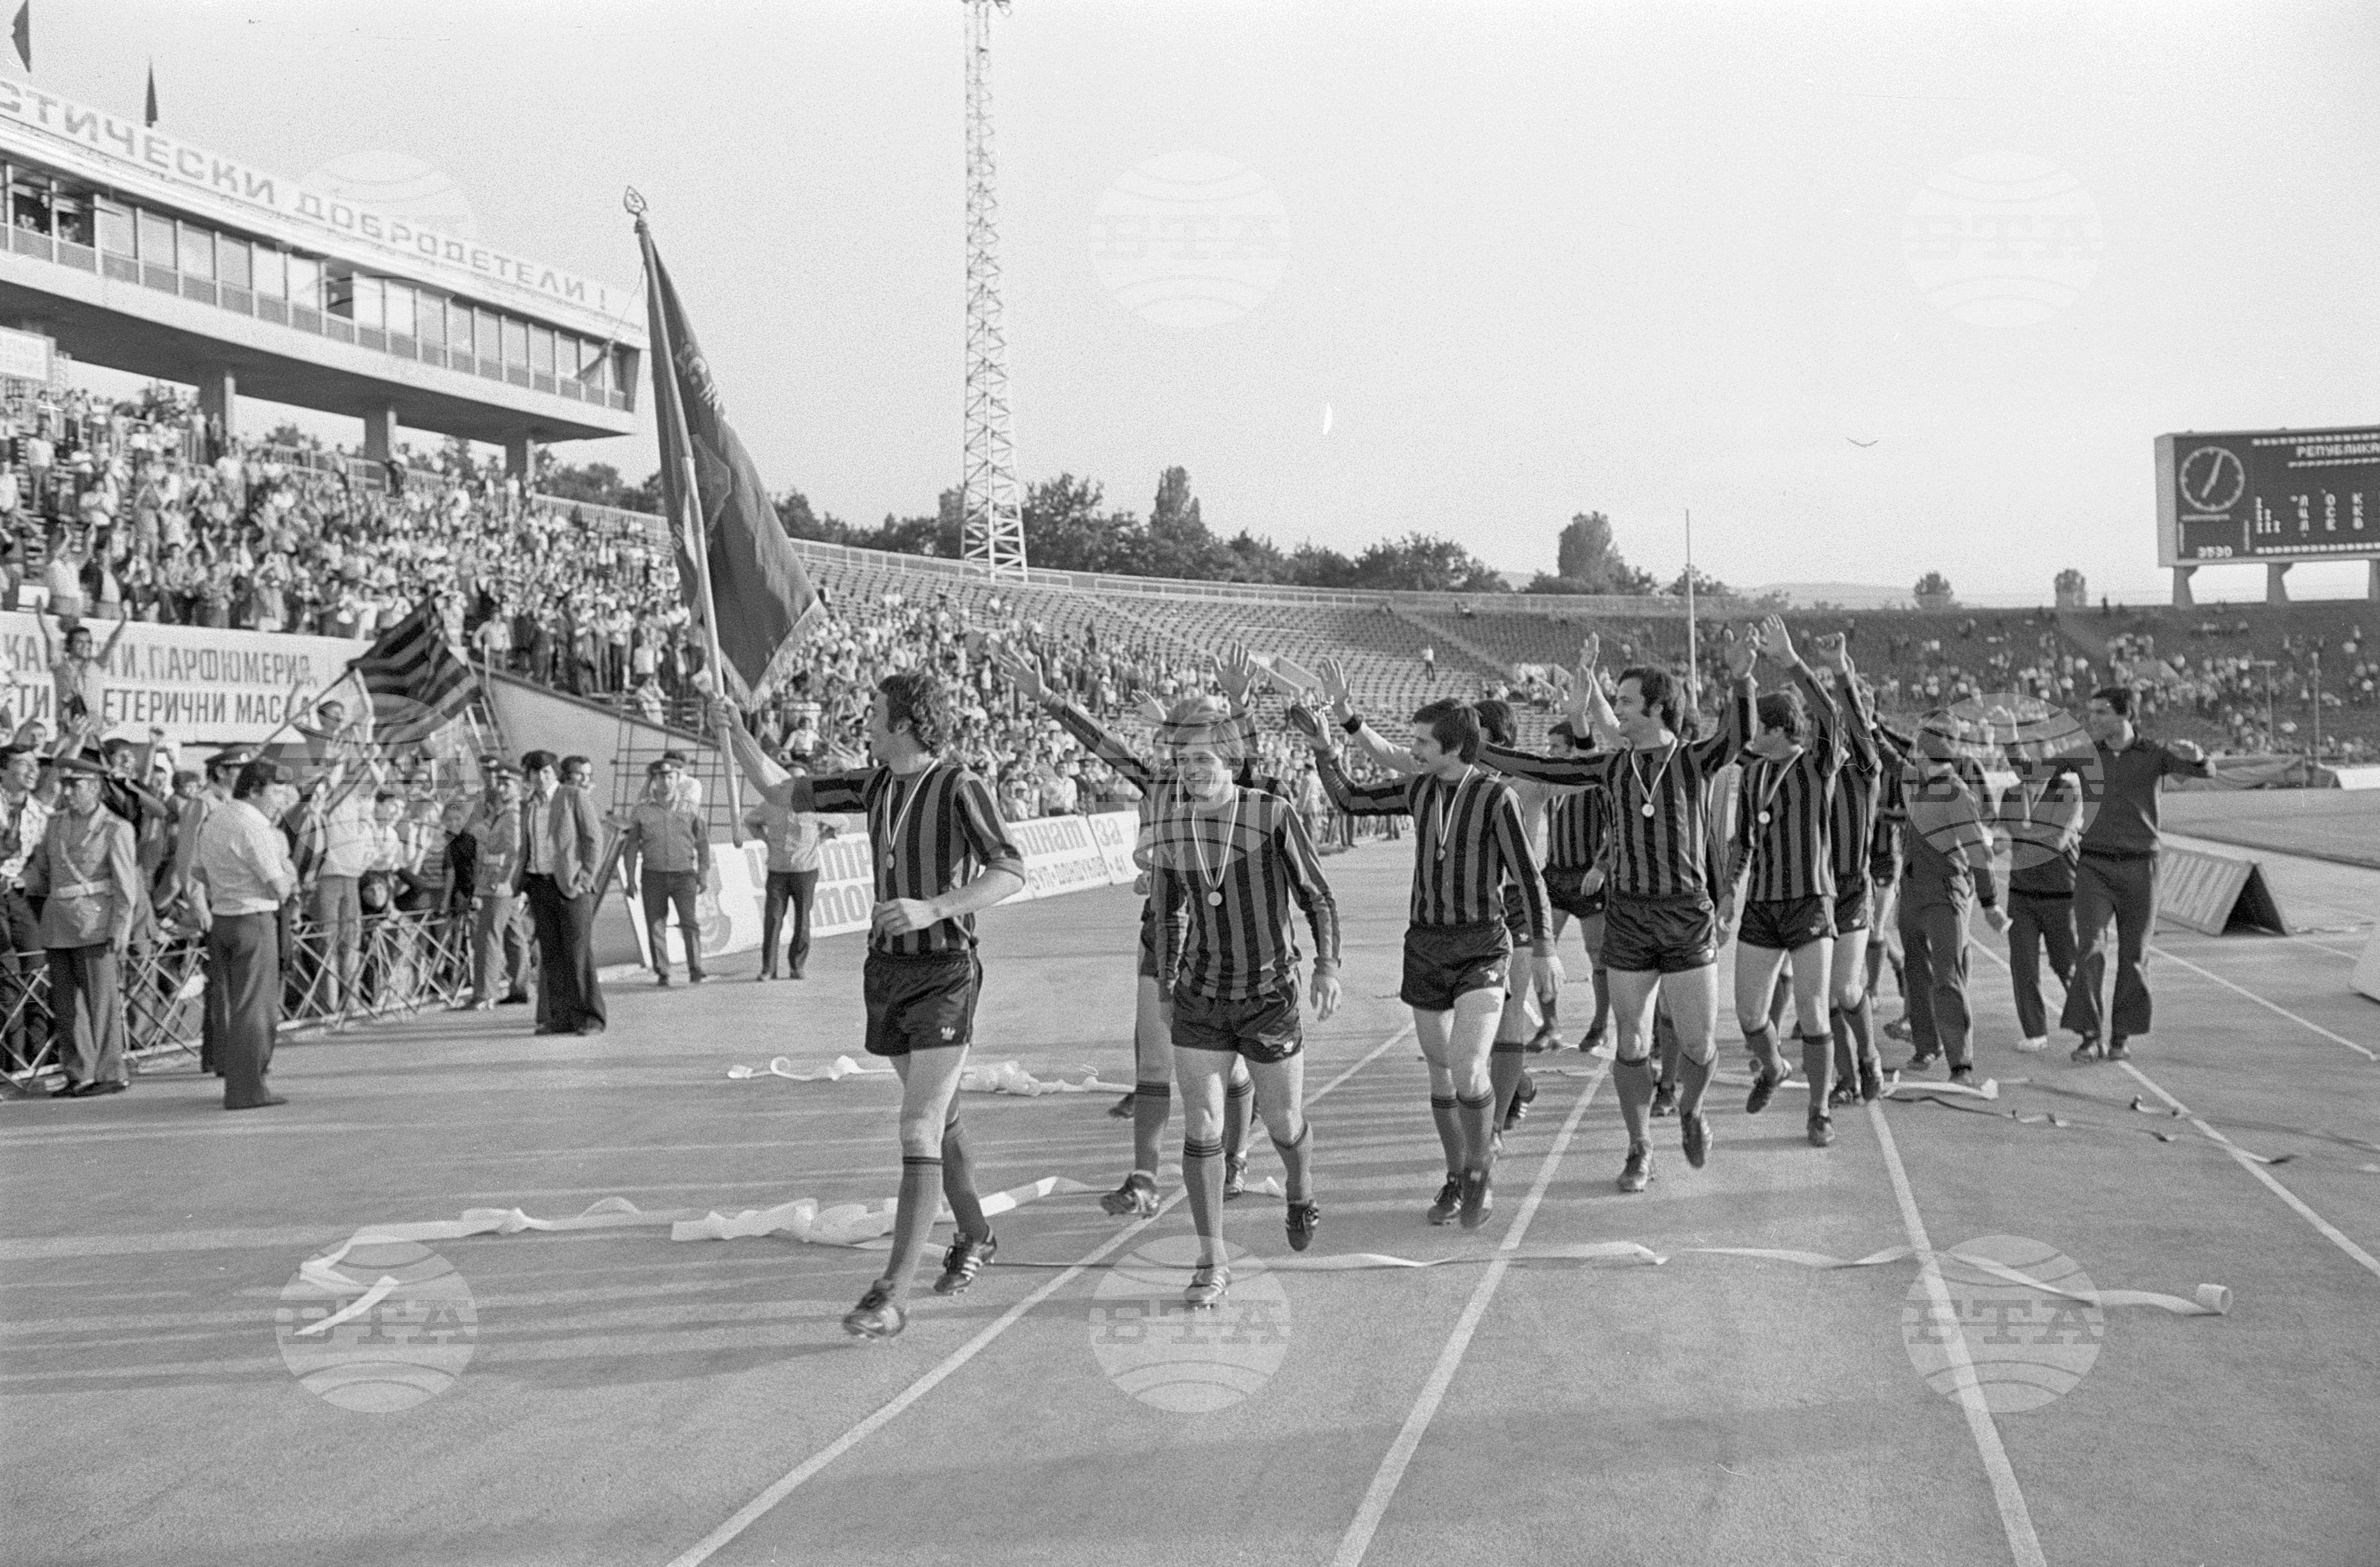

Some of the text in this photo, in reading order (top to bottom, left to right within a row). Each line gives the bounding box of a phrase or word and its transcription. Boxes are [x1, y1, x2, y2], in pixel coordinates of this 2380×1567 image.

[294, 191, 585, 301] ДОБРОДЕТЕЛИ
[102, 688, 226, 723] ЕТЕРИЧНИ
[236, 693, 312, 725] МАСА
